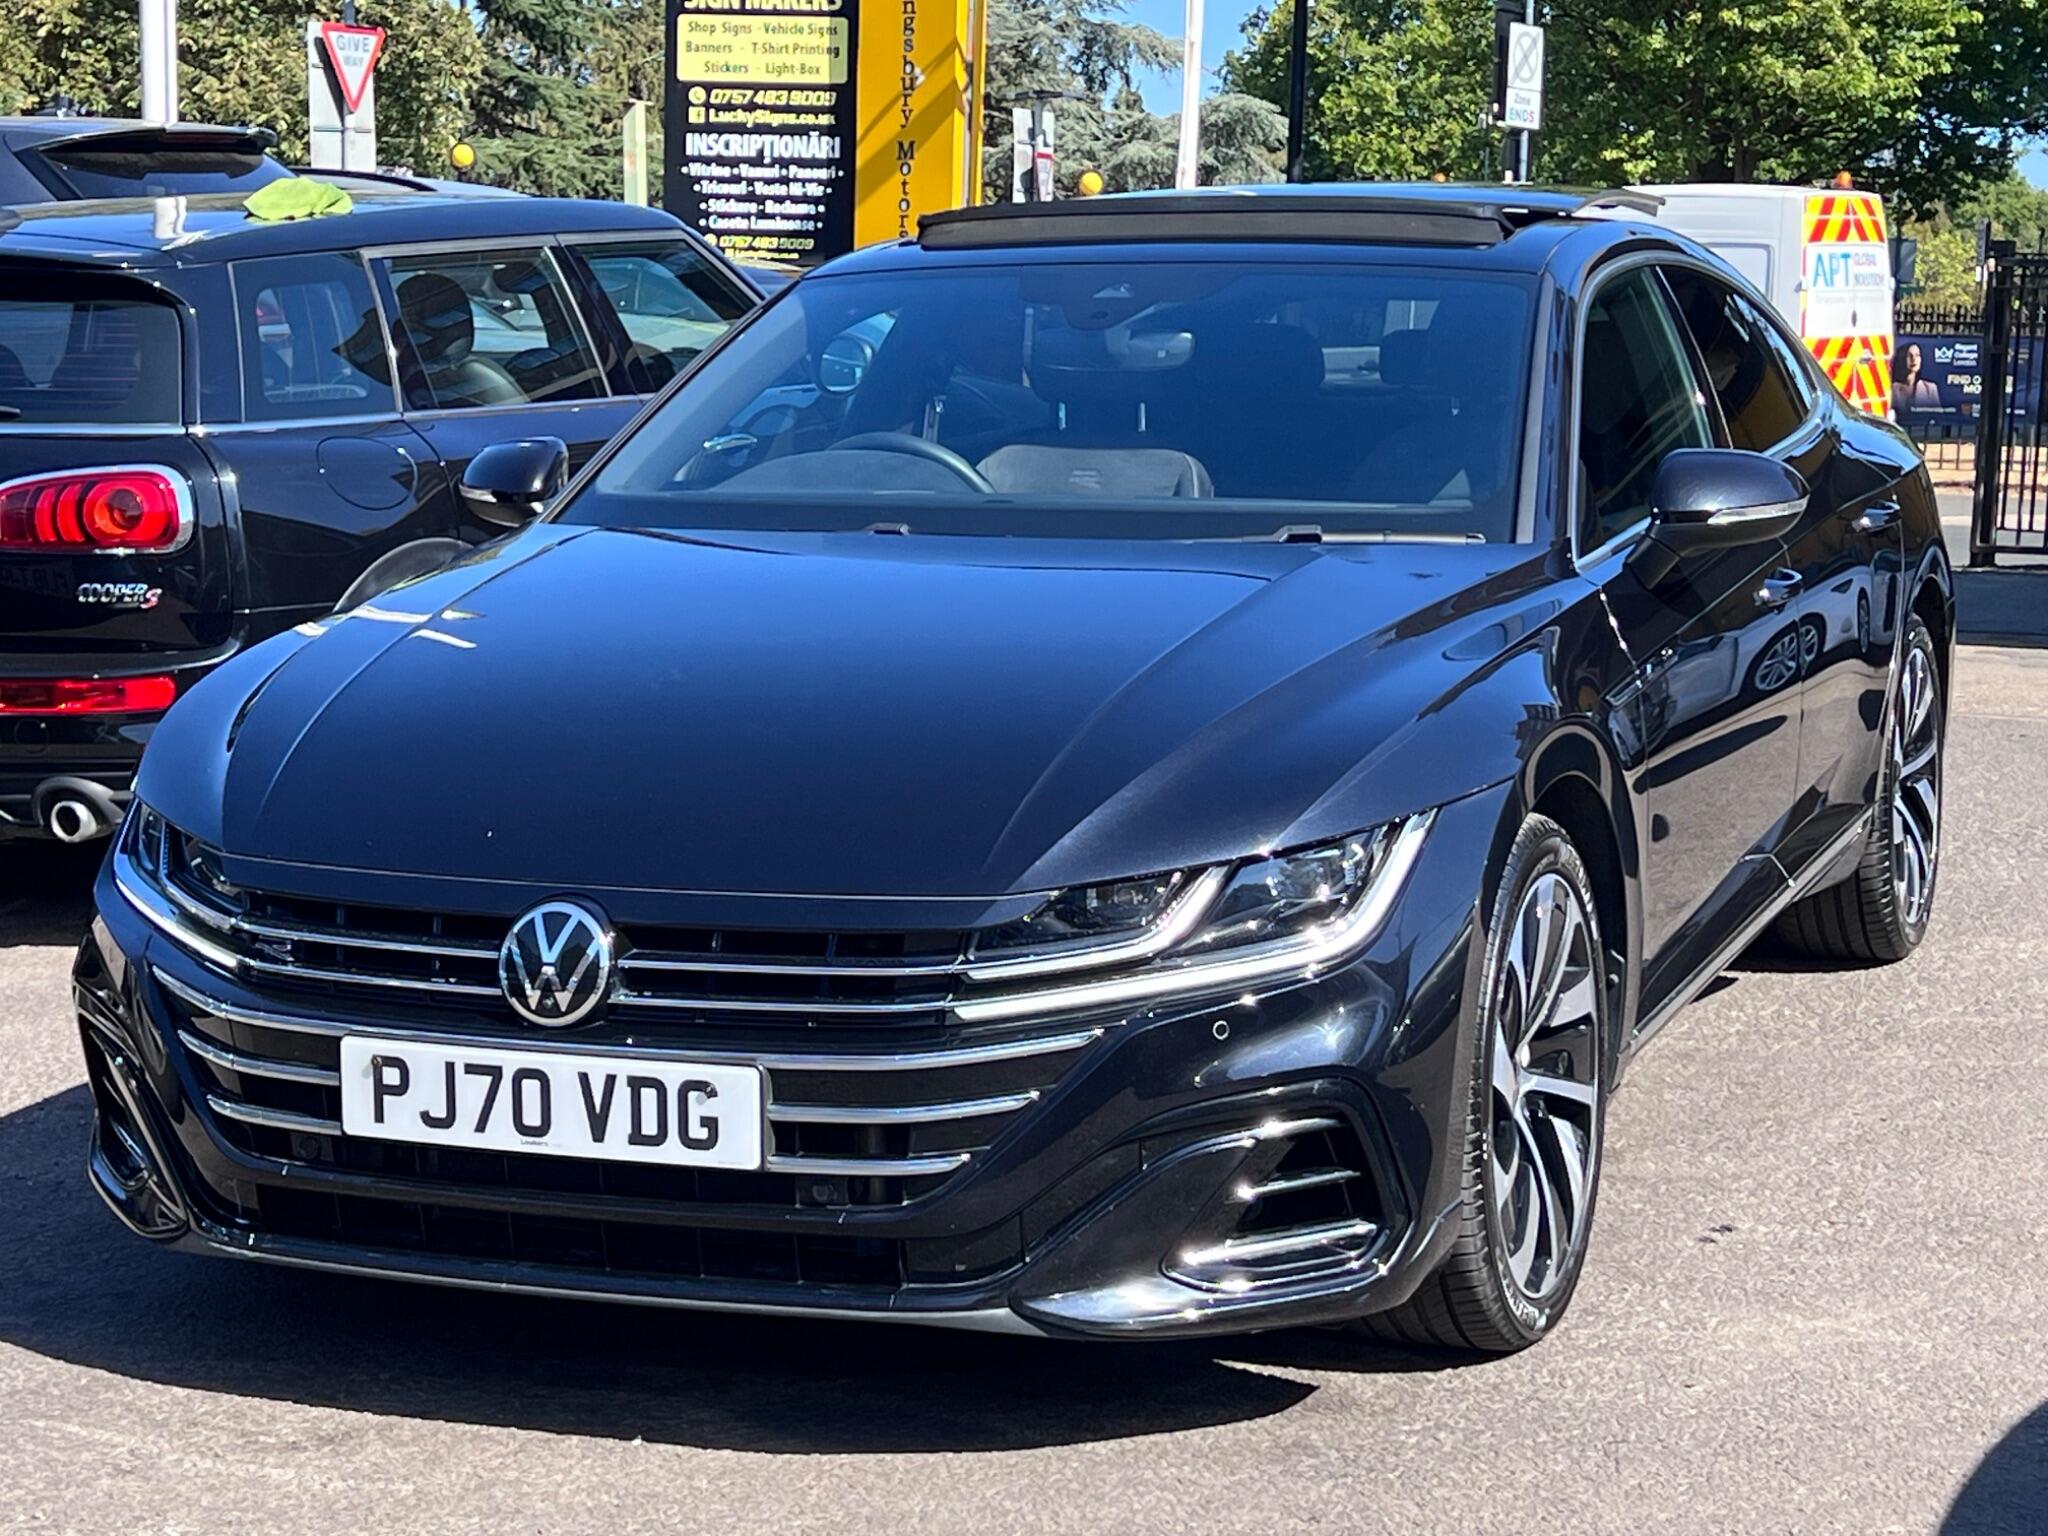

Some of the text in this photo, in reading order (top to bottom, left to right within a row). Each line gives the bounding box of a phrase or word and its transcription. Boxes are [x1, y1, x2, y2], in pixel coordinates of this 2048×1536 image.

[687, 21, 838, 38] Shop Signs Vehicle Signs
[336, 34, 370, 53] GIVE
[685, 41, 840, 58] Banners T-Shirt Printing
[704, 61, 821, 77] Stickers Light-Box
[709, 89, 754, 104] 0757
[753, 90, 788, 105] 483
[1508, 106, 1535, 124] ENDS
[77, 583, 162, 609] COOPER S
[371, 1054, 719, 1151] PJ70 VDG
